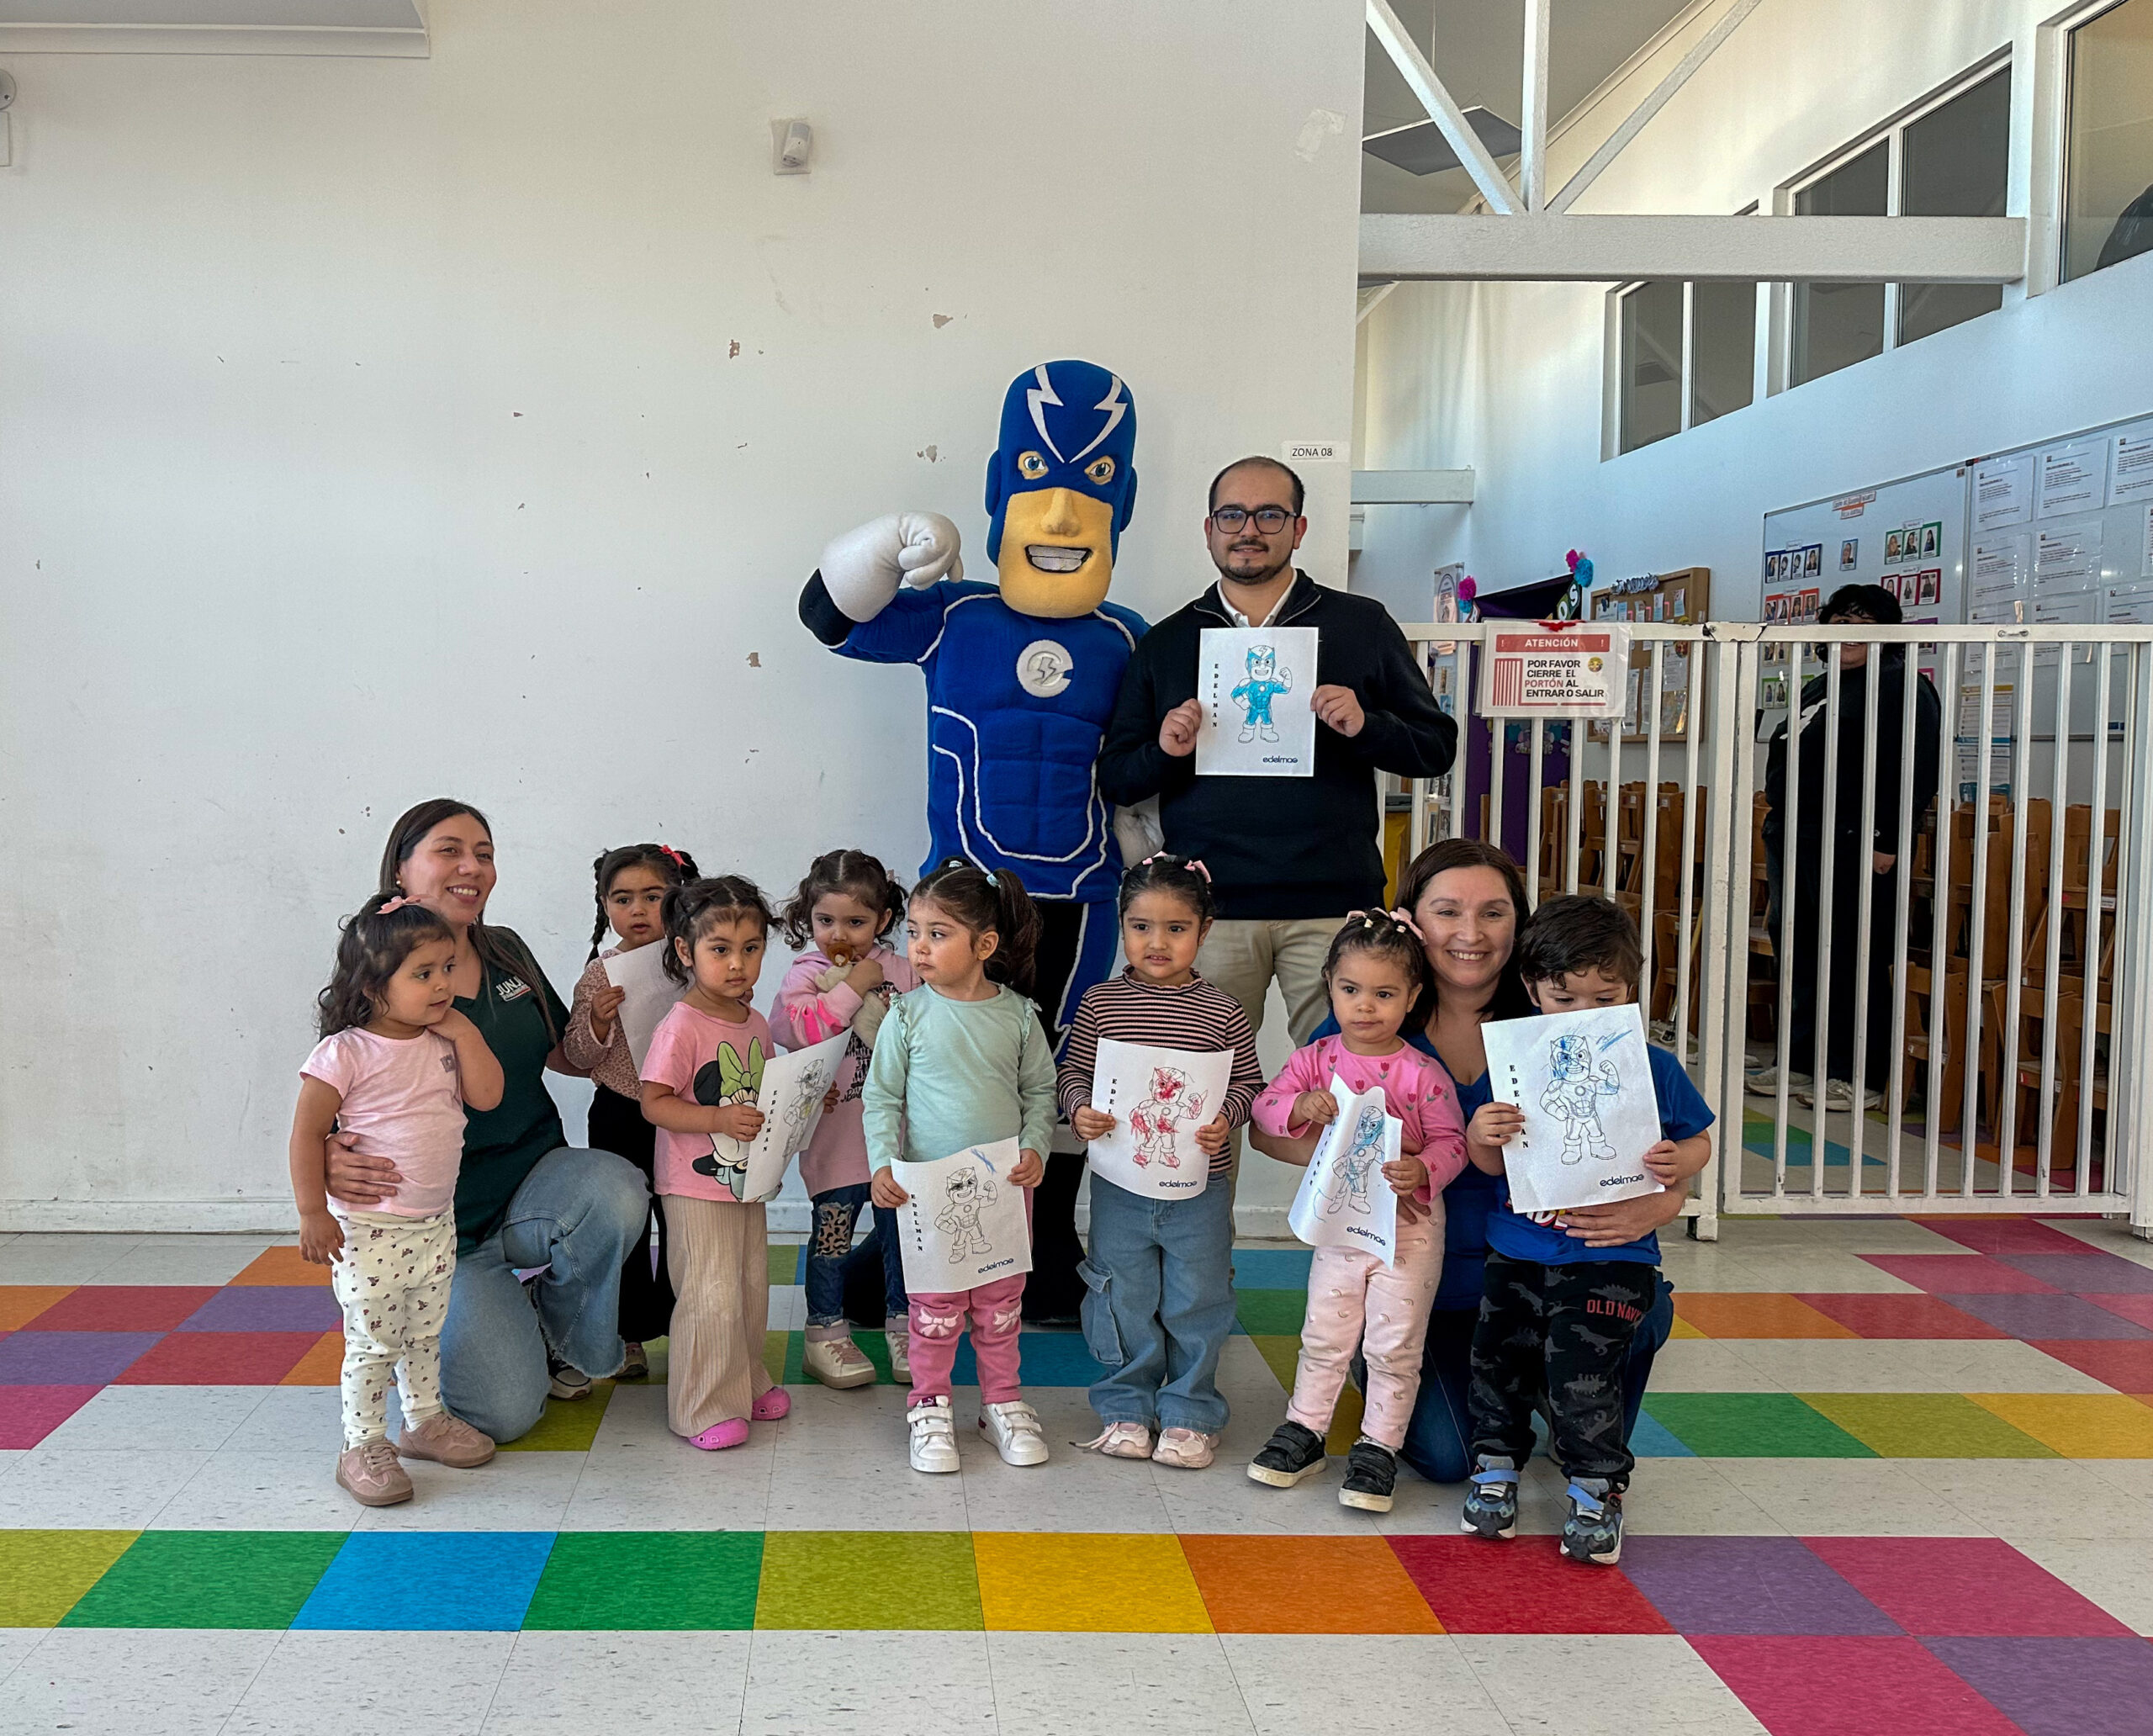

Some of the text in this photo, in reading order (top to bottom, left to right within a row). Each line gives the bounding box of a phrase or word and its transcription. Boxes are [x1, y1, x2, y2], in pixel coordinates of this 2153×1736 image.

[1292, 447, 1333, 457] ZONA 08
[1525, 638, 1579, 648] ATENCIÓN
[1525, 679, 1563, 687] PORTÓN
[1526, 689, 1604, 697] ENTRAR O SALIR
[1509, 1064, 1529, 1149] EDELAN
[910, 1194, 923, 1252] EDELMAN
[1586, 1299, 1643, 1323] OLD NAVY
